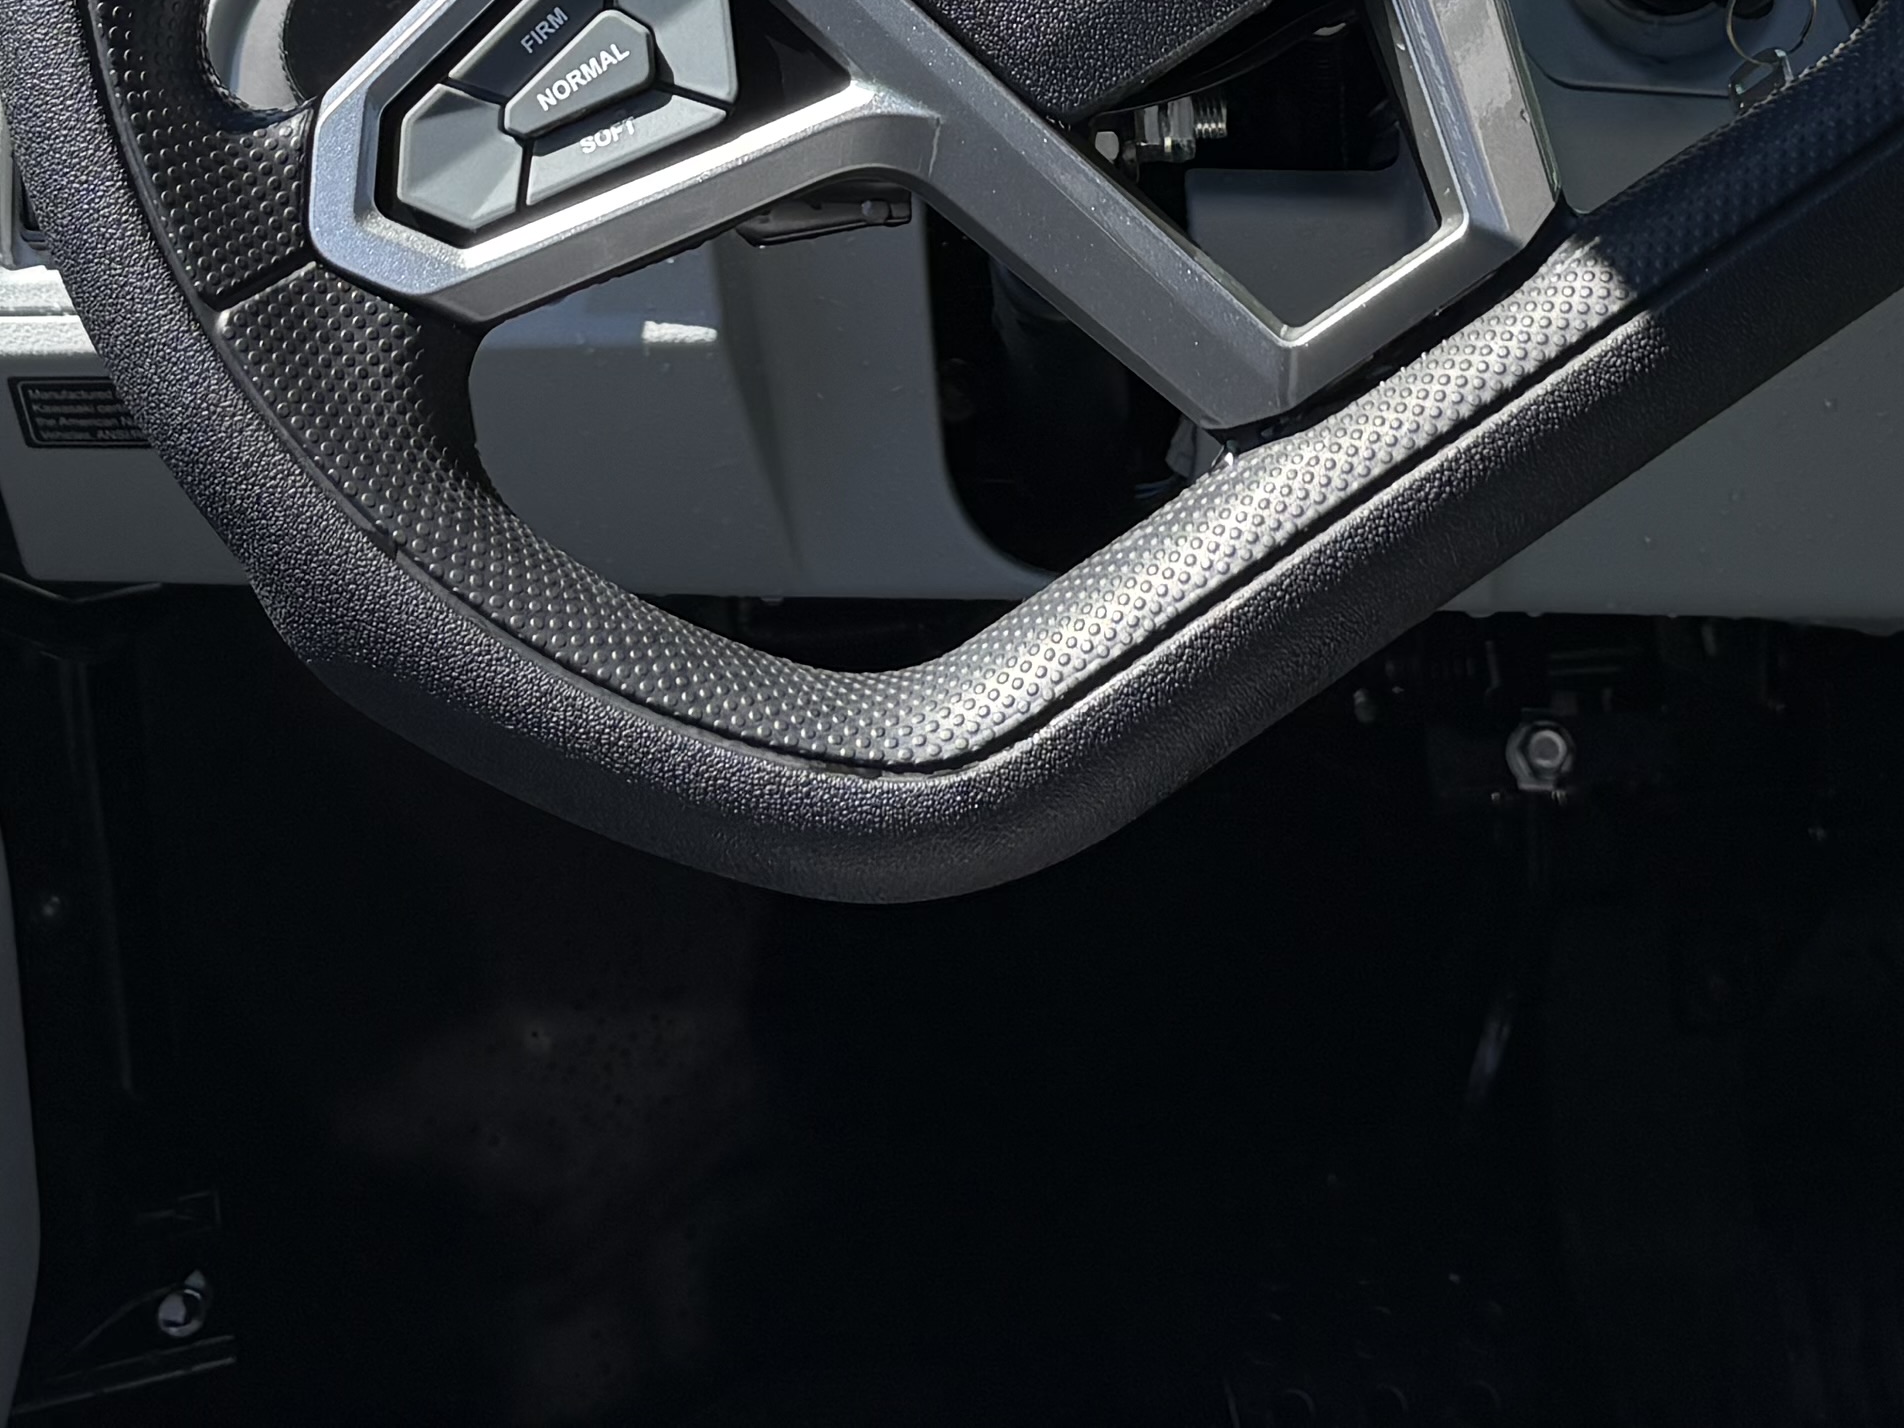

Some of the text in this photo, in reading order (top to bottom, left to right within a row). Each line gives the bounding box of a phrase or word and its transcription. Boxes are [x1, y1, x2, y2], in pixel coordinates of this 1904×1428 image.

[520, 6, 569, 54] FIRM
[536, 43, 631, 112] NORMAL
[579, 115, 636, 154] SOFT
